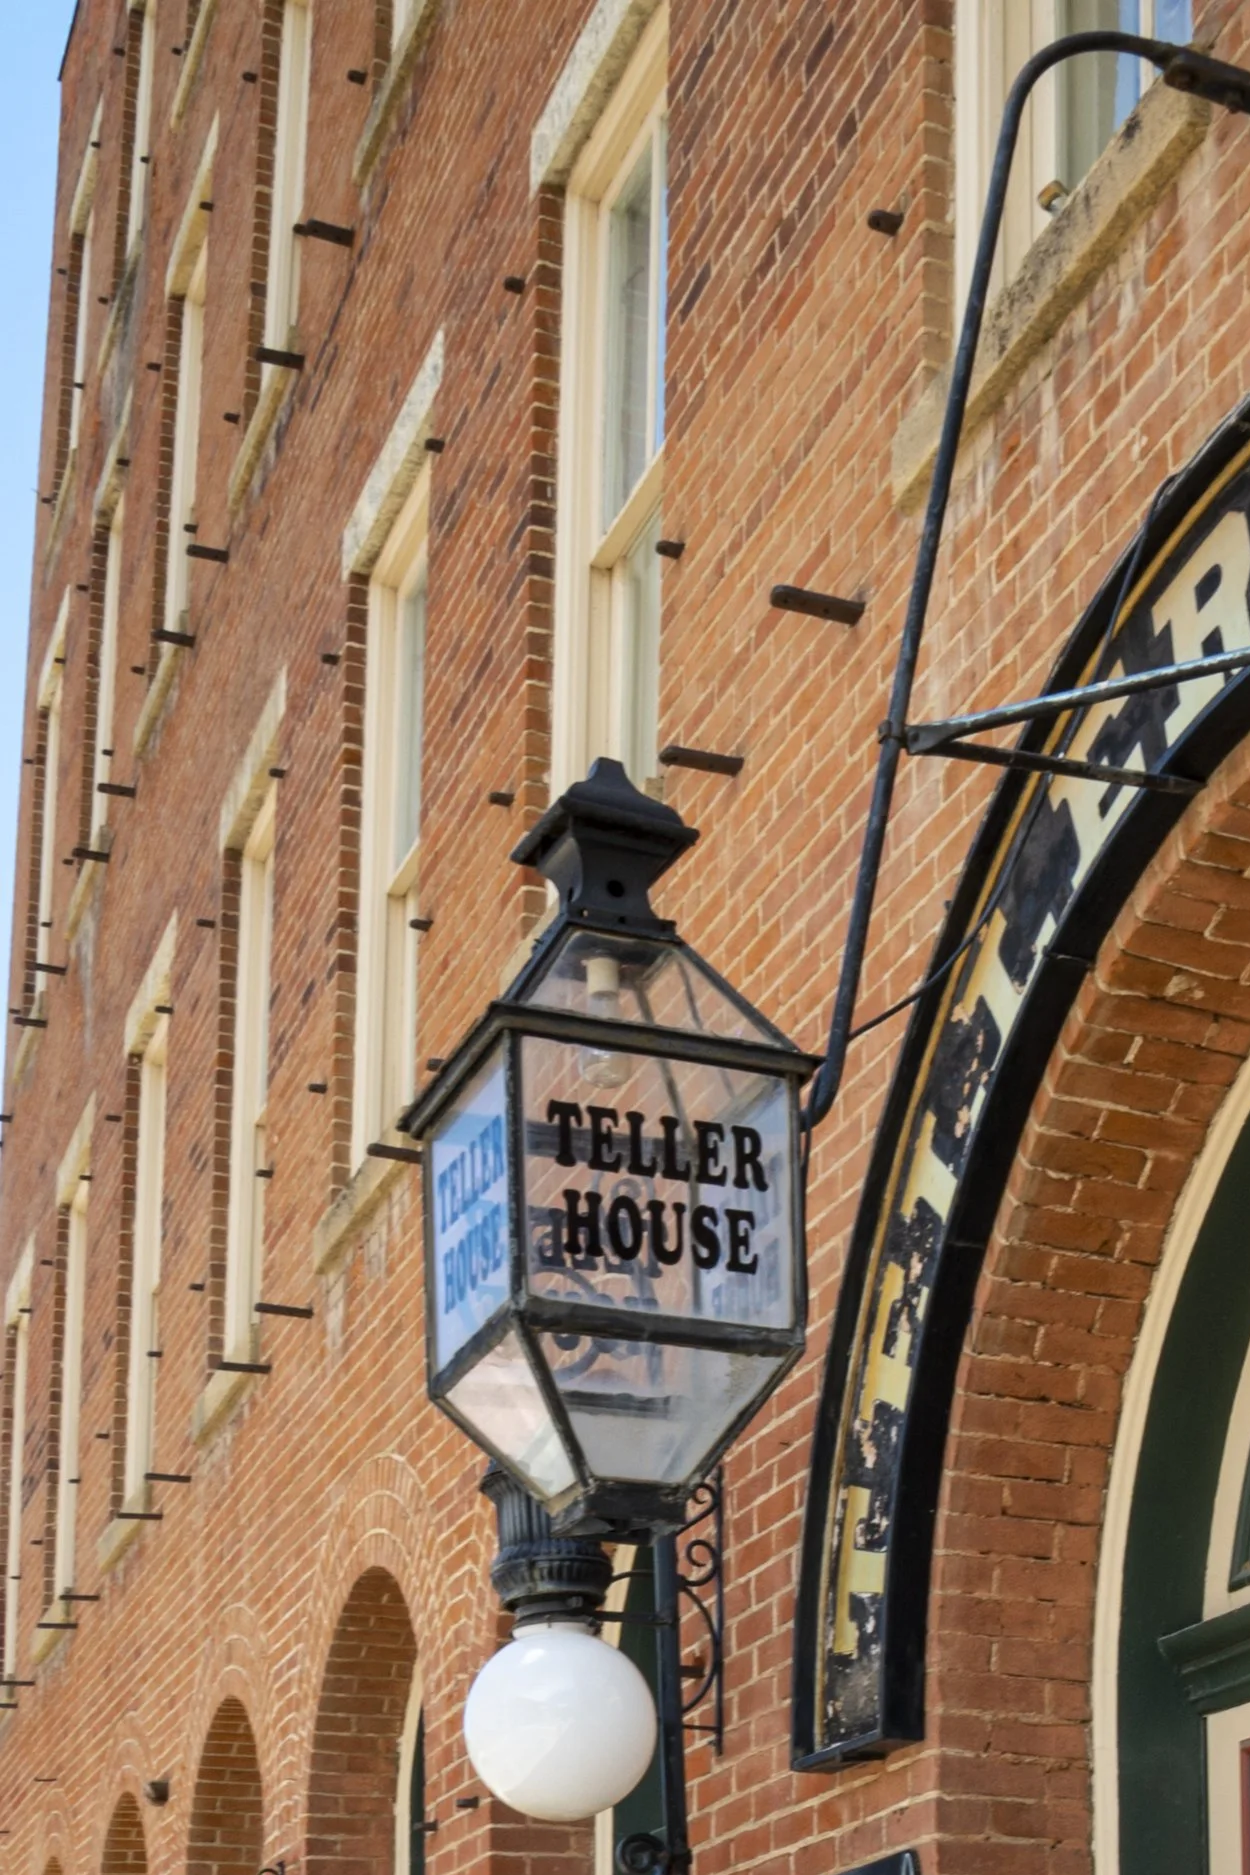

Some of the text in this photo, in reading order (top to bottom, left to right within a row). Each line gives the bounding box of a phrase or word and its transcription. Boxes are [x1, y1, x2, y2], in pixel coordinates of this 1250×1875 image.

[437, 1114, 505, 1234] TELLER
[547, 1099, 768, 1192] TELLER
[443, 1203, 505, 1314] HOUSE
[563, 1189, 759, 1275] HOUSE
